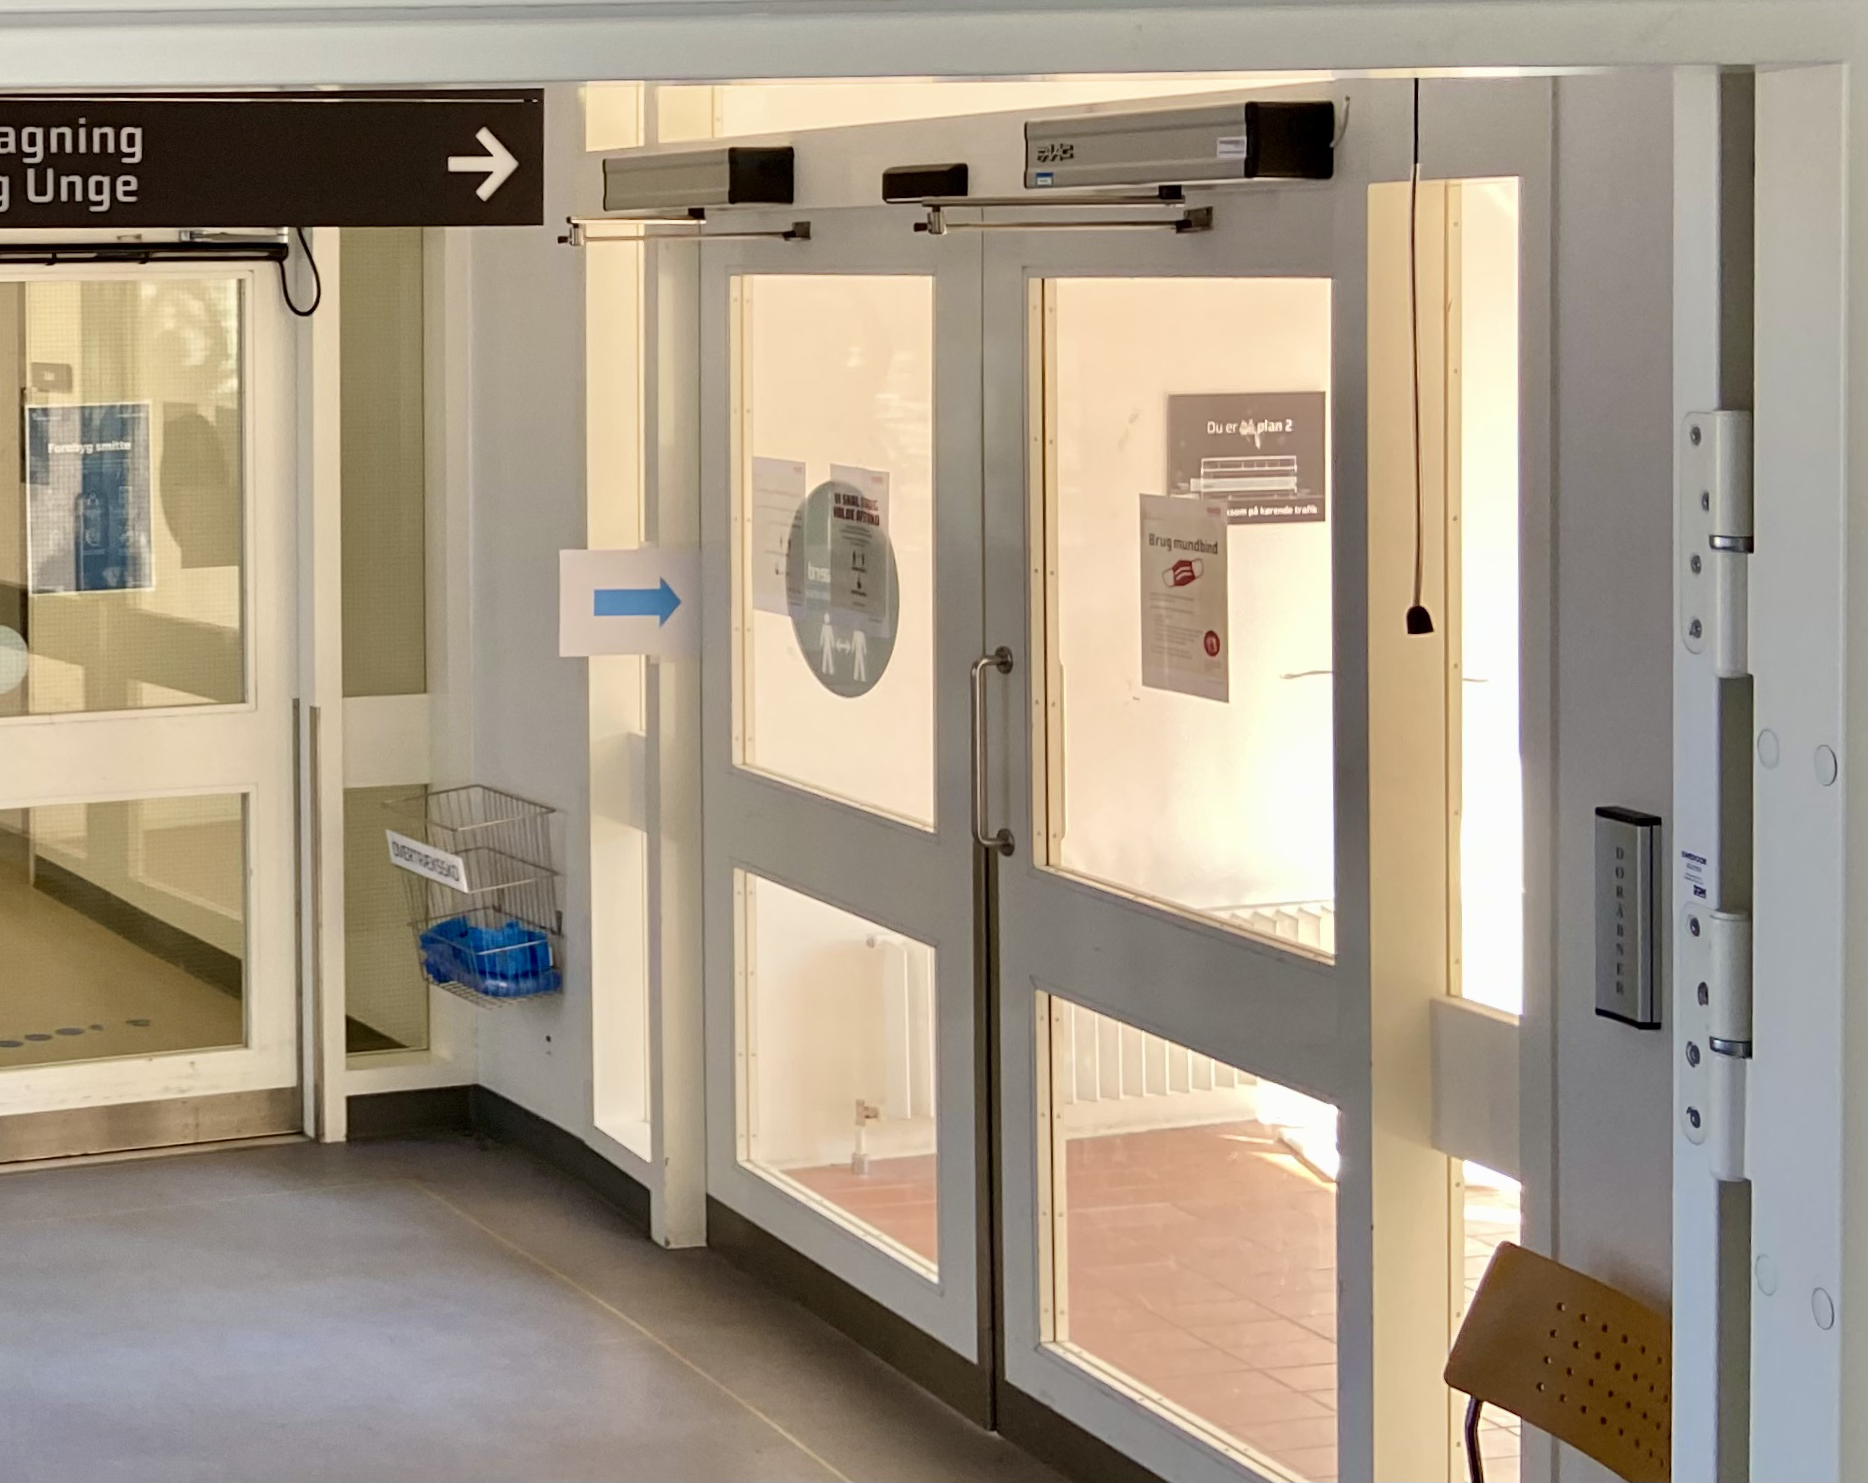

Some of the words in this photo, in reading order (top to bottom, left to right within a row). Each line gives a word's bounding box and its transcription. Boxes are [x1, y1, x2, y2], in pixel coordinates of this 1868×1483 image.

[26, 168, 139, 212] Unge
[1207, 421, 1223, 434] Du
[1226, 422, 1237, 433] er
[1256, 419, 1283, 434] plan
[1285, 419, 1293, 432] 2
[1149, 533, 1172, 552] Brug
[1174, 538, 1218, 554] mundbind
